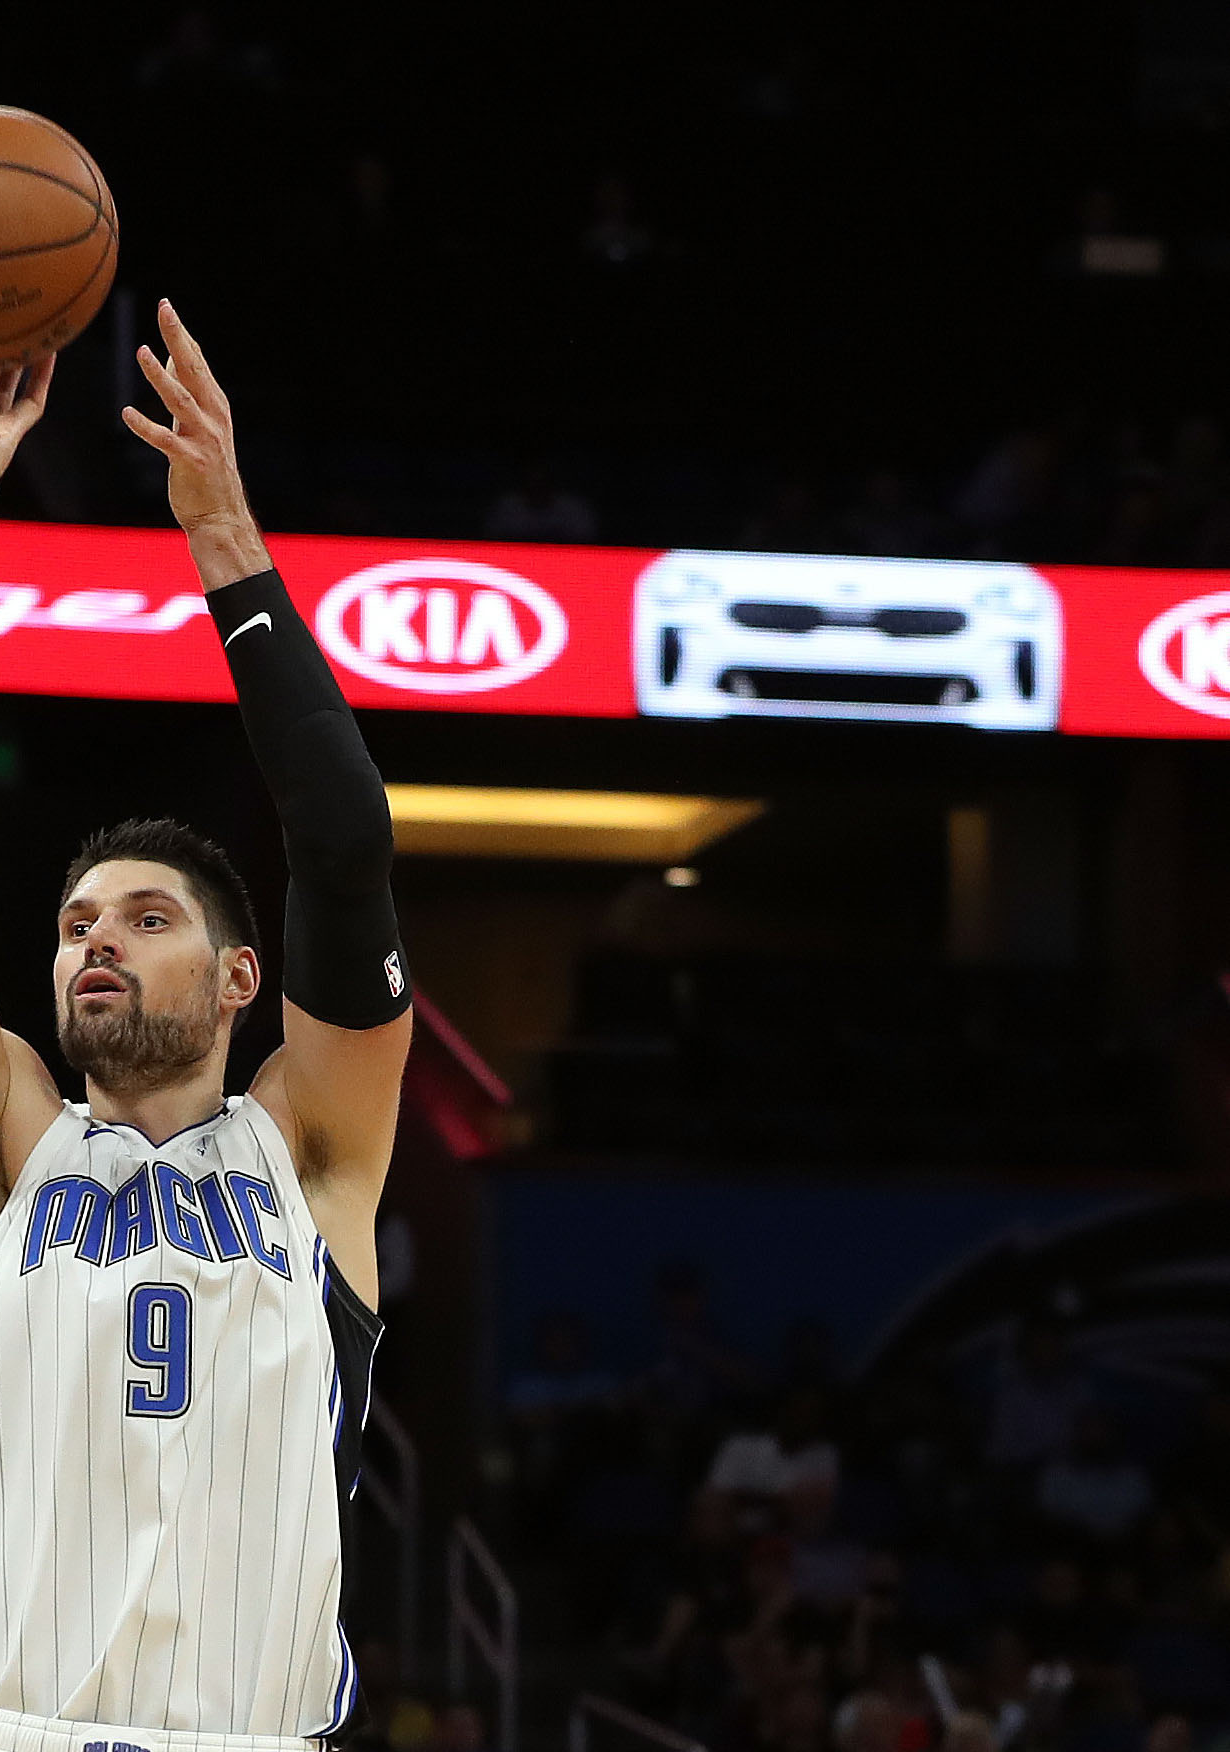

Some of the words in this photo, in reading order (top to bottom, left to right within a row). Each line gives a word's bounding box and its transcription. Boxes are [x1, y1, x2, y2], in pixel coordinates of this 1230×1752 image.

[359, 586, 527, 666] KIA
[20, 1160, 292, 1282] MAGIC
[125, 1281, 193, 1420] 9
